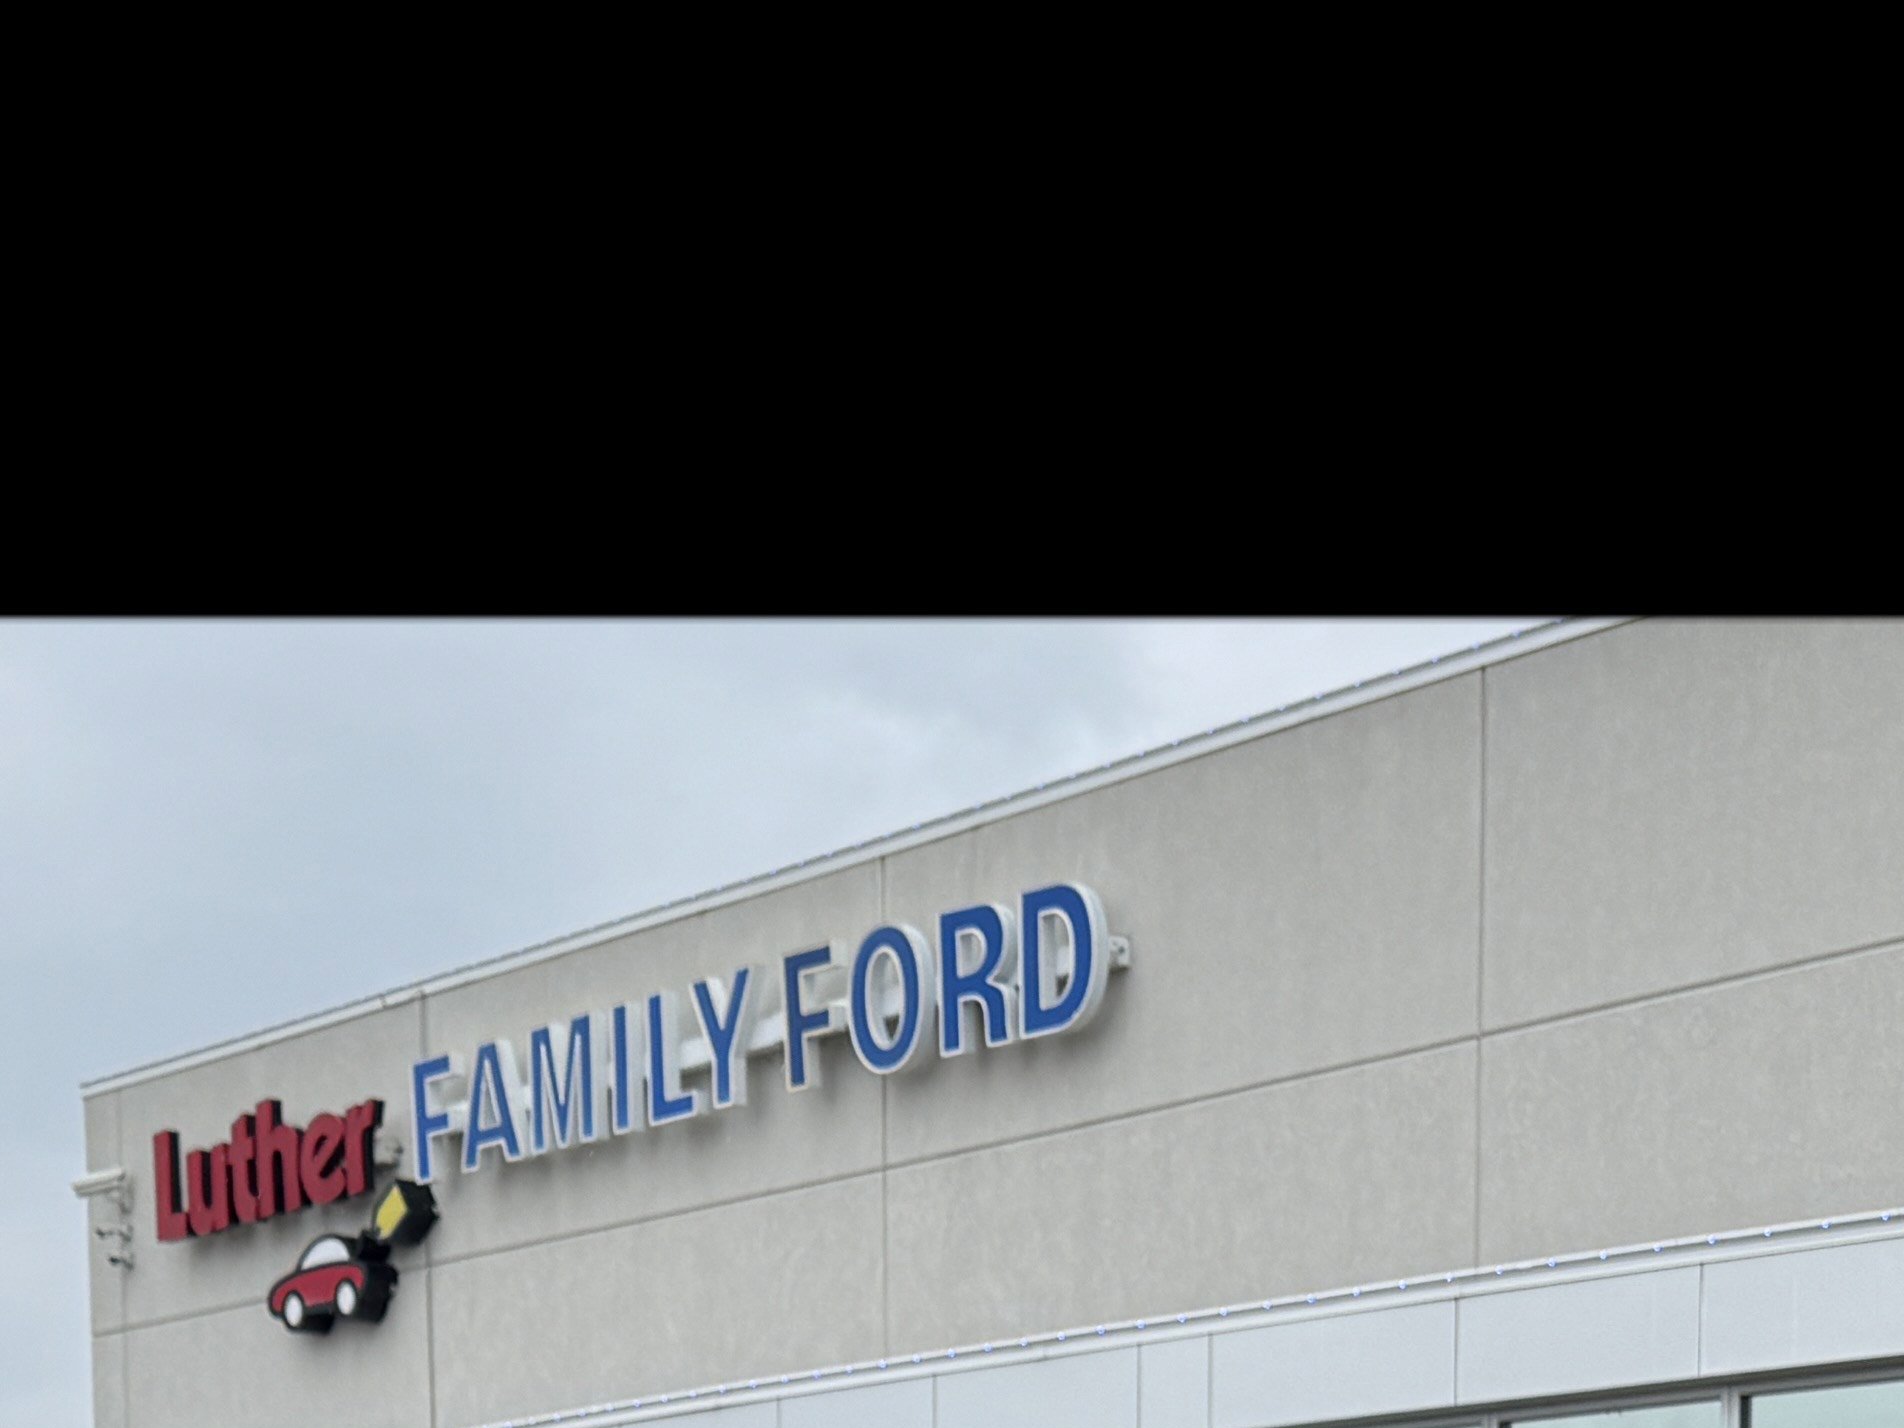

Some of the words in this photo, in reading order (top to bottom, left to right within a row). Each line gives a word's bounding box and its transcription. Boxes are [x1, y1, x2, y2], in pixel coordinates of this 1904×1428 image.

[407, 966, 756, 1185] FAMILY
[782, 882, 1104, 1094] FORD
[153, 1098, 384, 1243] Luther
